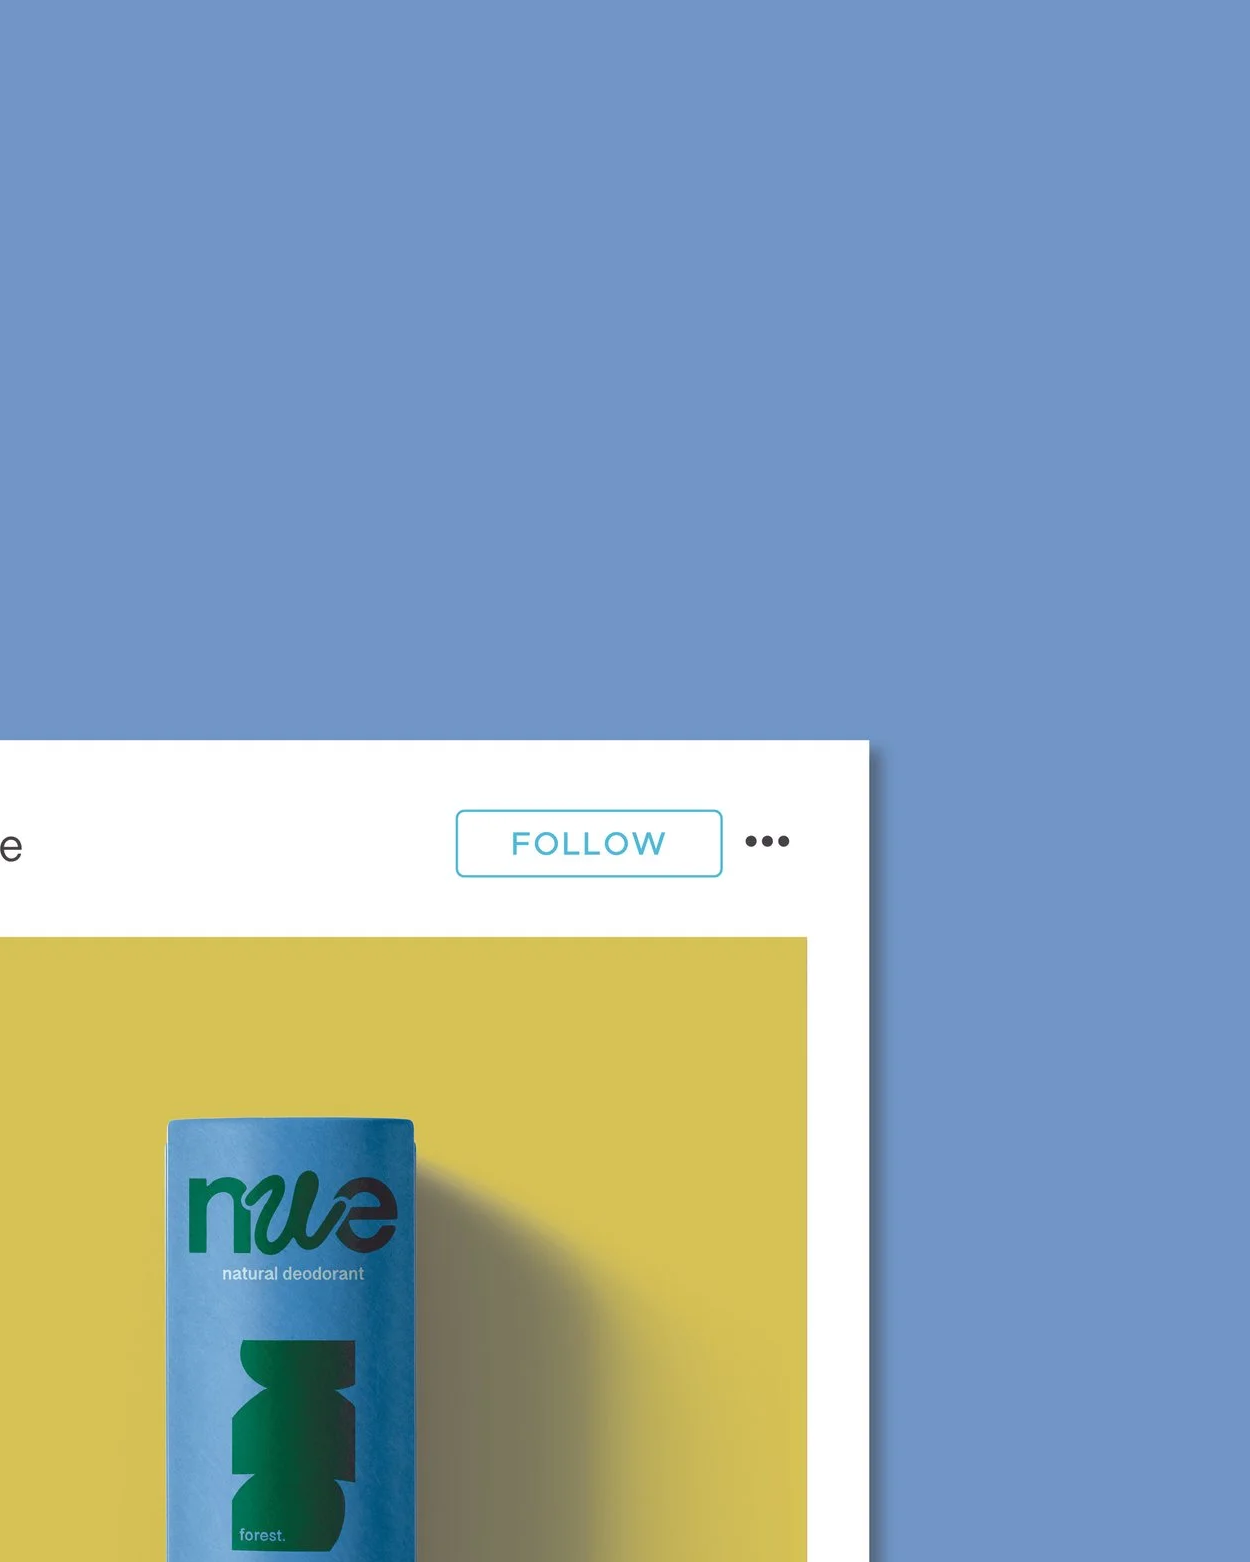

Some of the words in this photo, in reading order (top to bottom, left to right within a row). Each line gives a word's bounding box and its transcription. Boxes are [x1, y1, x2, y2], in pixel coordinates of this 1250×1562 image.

[511, 831, 666, 856] FOLLOW
[188, 1170, 399, 1256] nue
[222, 1265, 278, 1281] natural
[282, 1265, 365, 1281] deodorant
[238, 1527, 286, 1543] forest.
